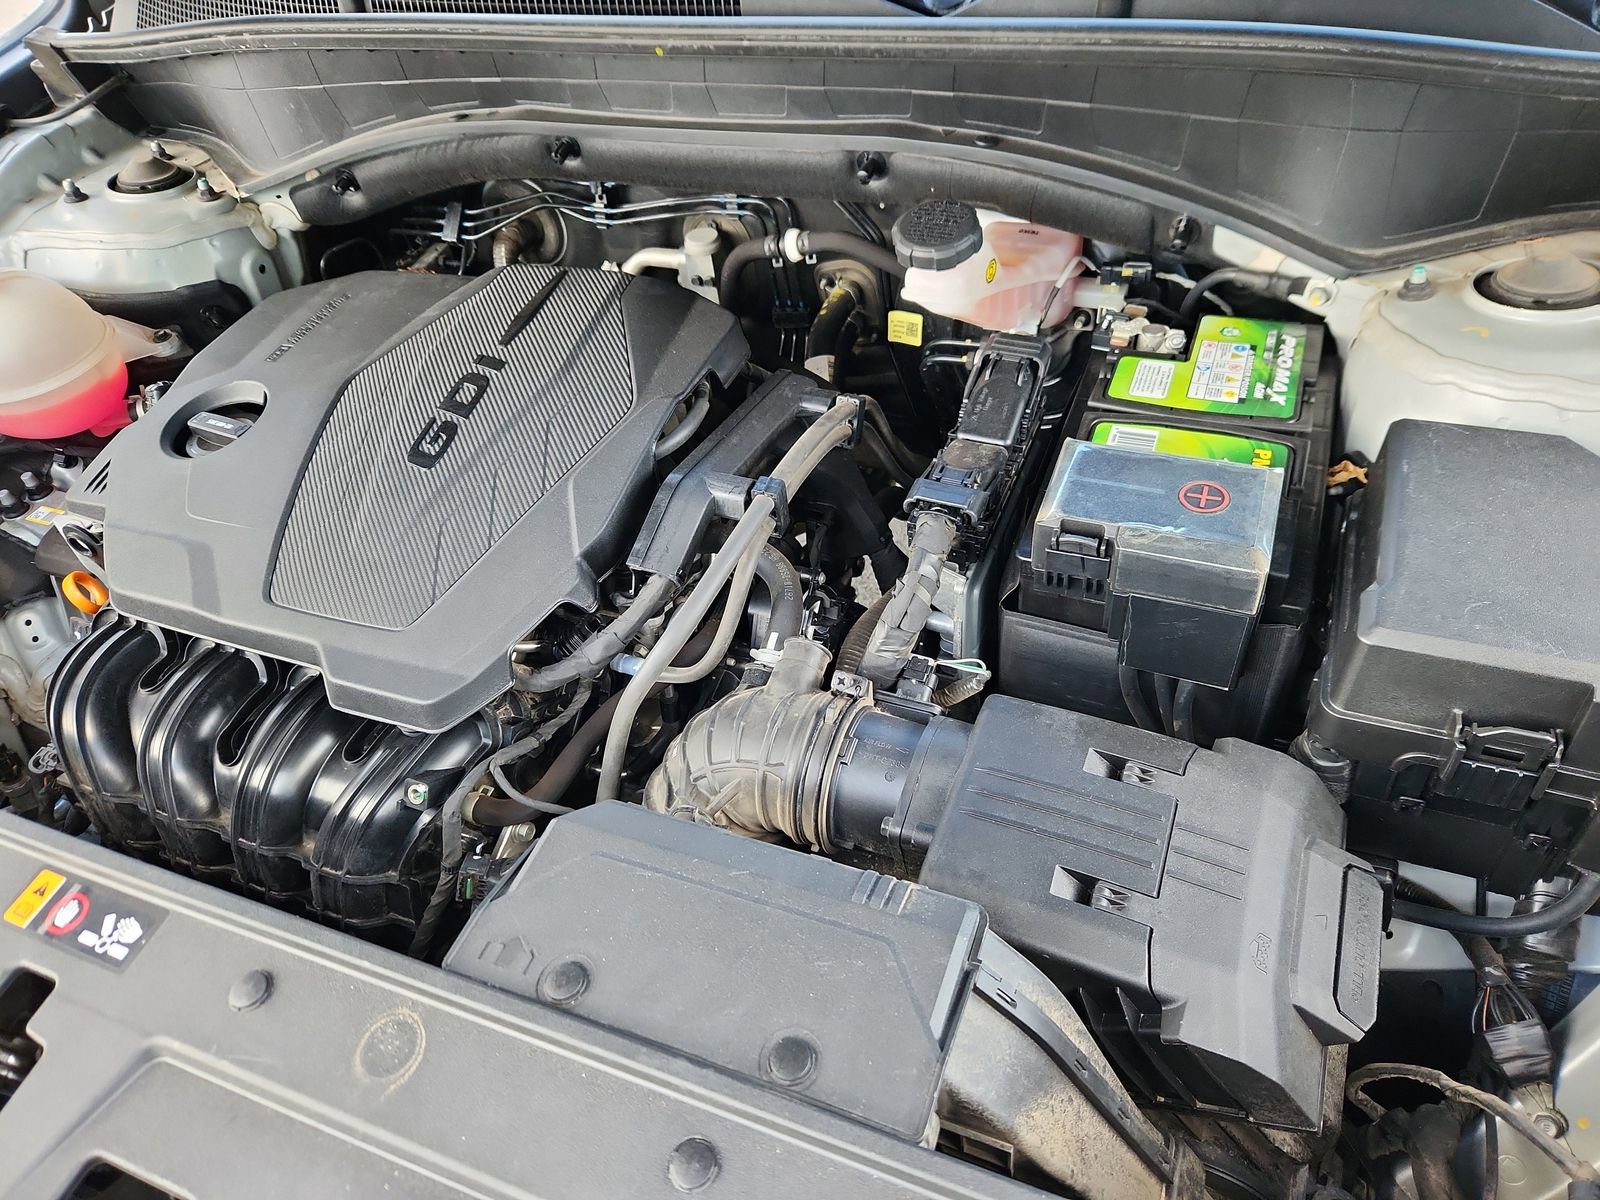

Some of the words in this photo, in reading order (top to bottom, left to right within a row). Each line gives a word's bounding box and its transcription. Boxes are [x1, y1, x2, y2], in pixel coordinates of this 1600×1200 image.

[1253, 382, 1266, 399] AGM
[1266, 334, 1297, 406] PROMAX
[407, 354, 507, 468] GDI
